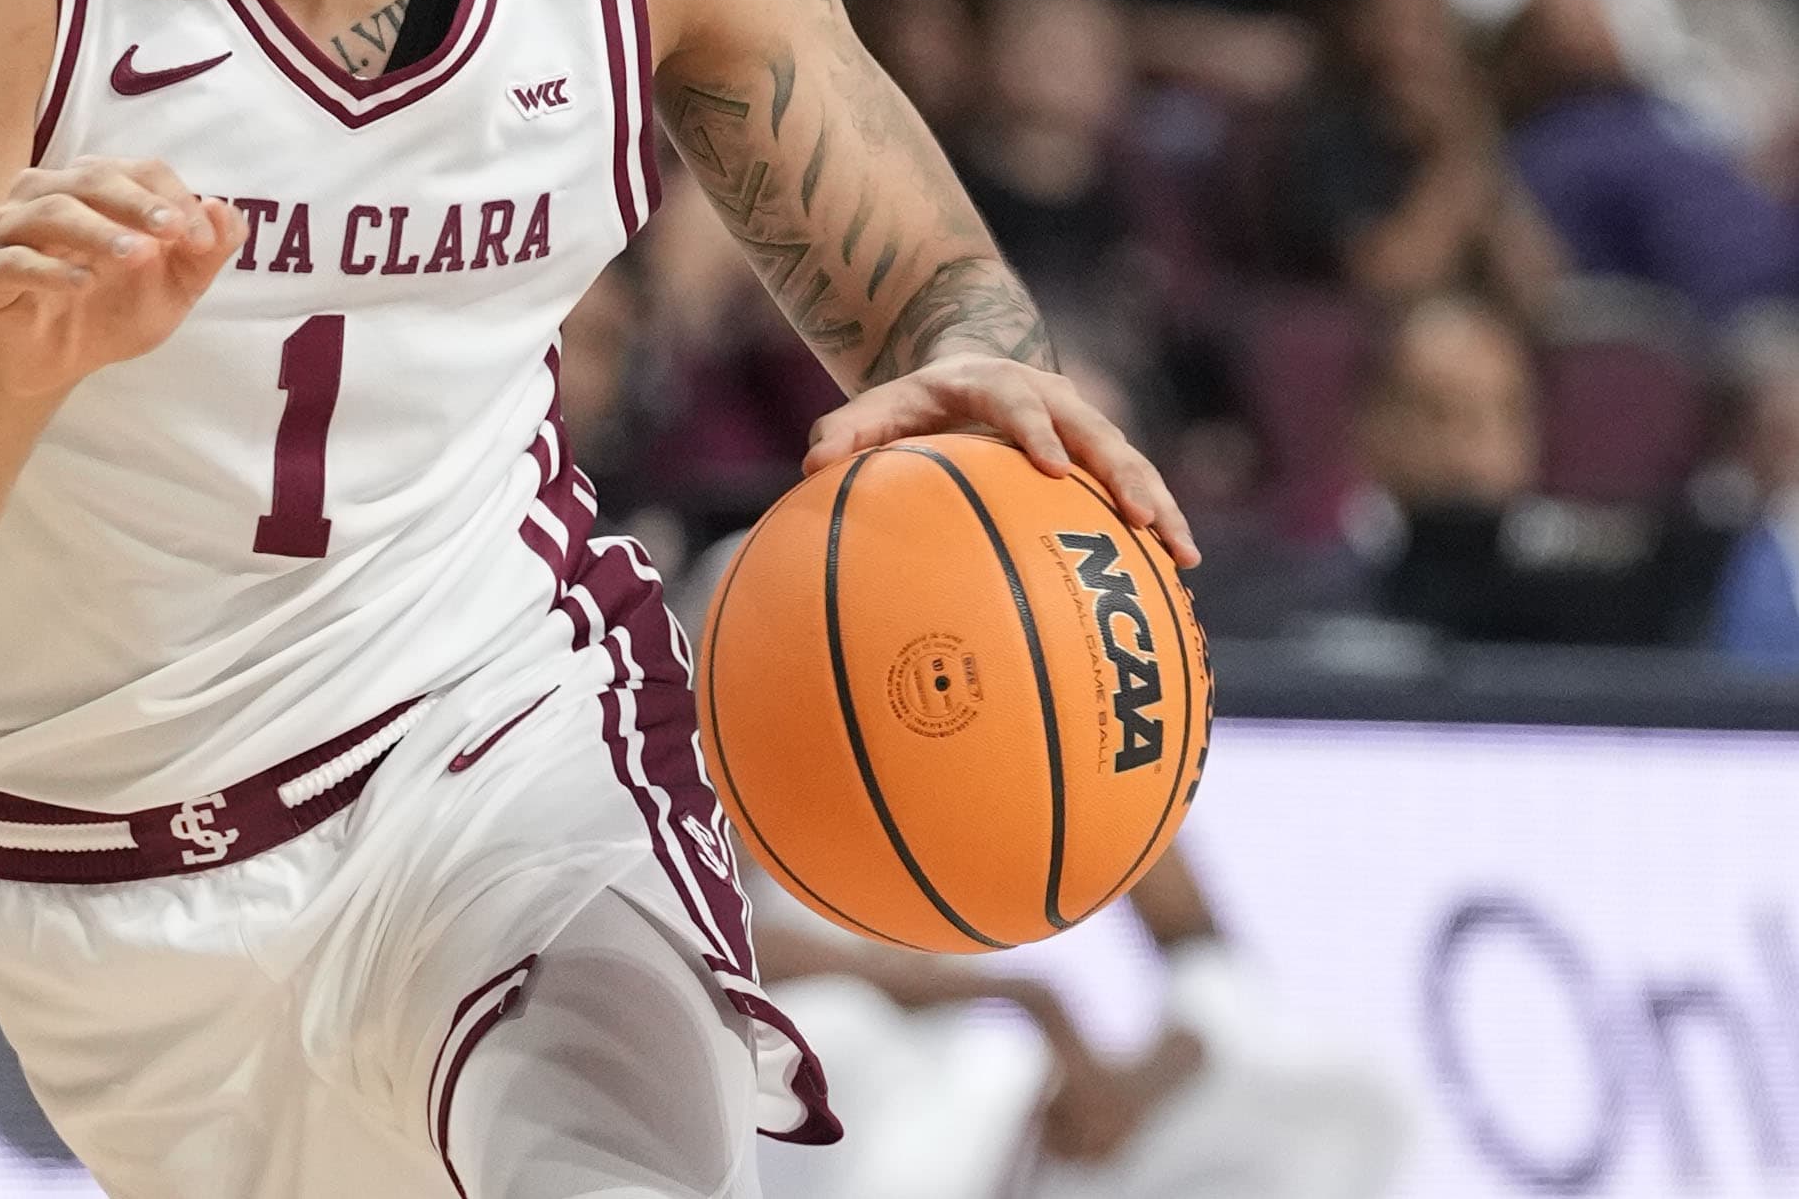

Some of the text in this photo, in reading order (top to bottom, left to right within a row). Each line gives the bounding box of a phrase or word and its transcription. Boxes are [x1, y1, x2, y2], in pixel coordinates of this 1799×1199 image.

[512, 77, 570, 112] WCC
[340, 192, 552, 276] CLARA
[253, 314, 345, 558] 1
[1039, 534, 1109, 774] OFFICIAL GAME BALL
[1053, 531, 1166, 775] NCAA
